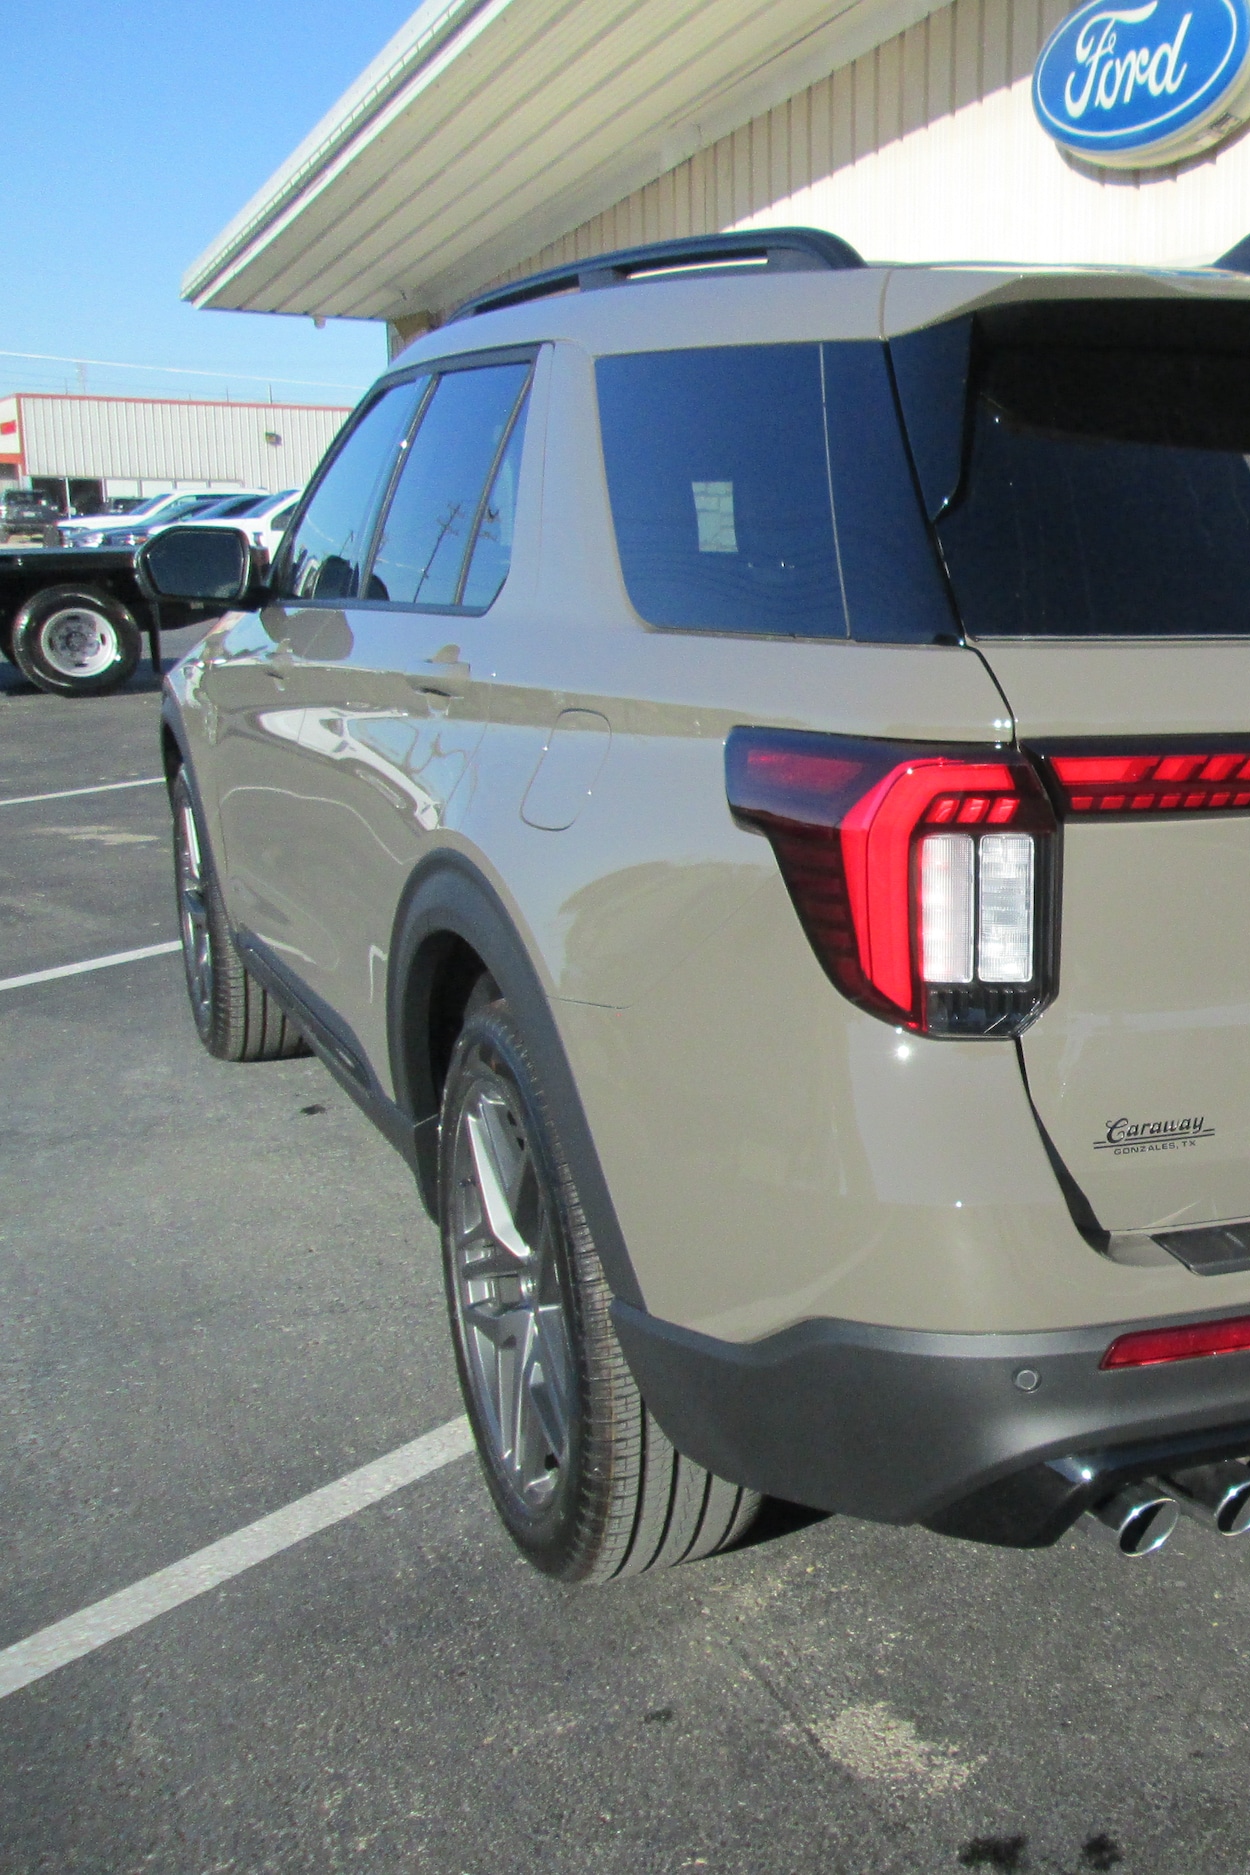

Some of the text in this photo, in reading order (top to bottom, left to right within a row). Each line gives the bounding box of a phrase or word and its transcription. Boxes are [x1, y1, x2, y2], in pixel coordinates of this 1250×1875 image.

[1064, 0, 1193, 118] Ford
[1105, 1116, 1204, 1143] Caraway
[1113, 1139, 1197, 1155] GONZALES, TX
